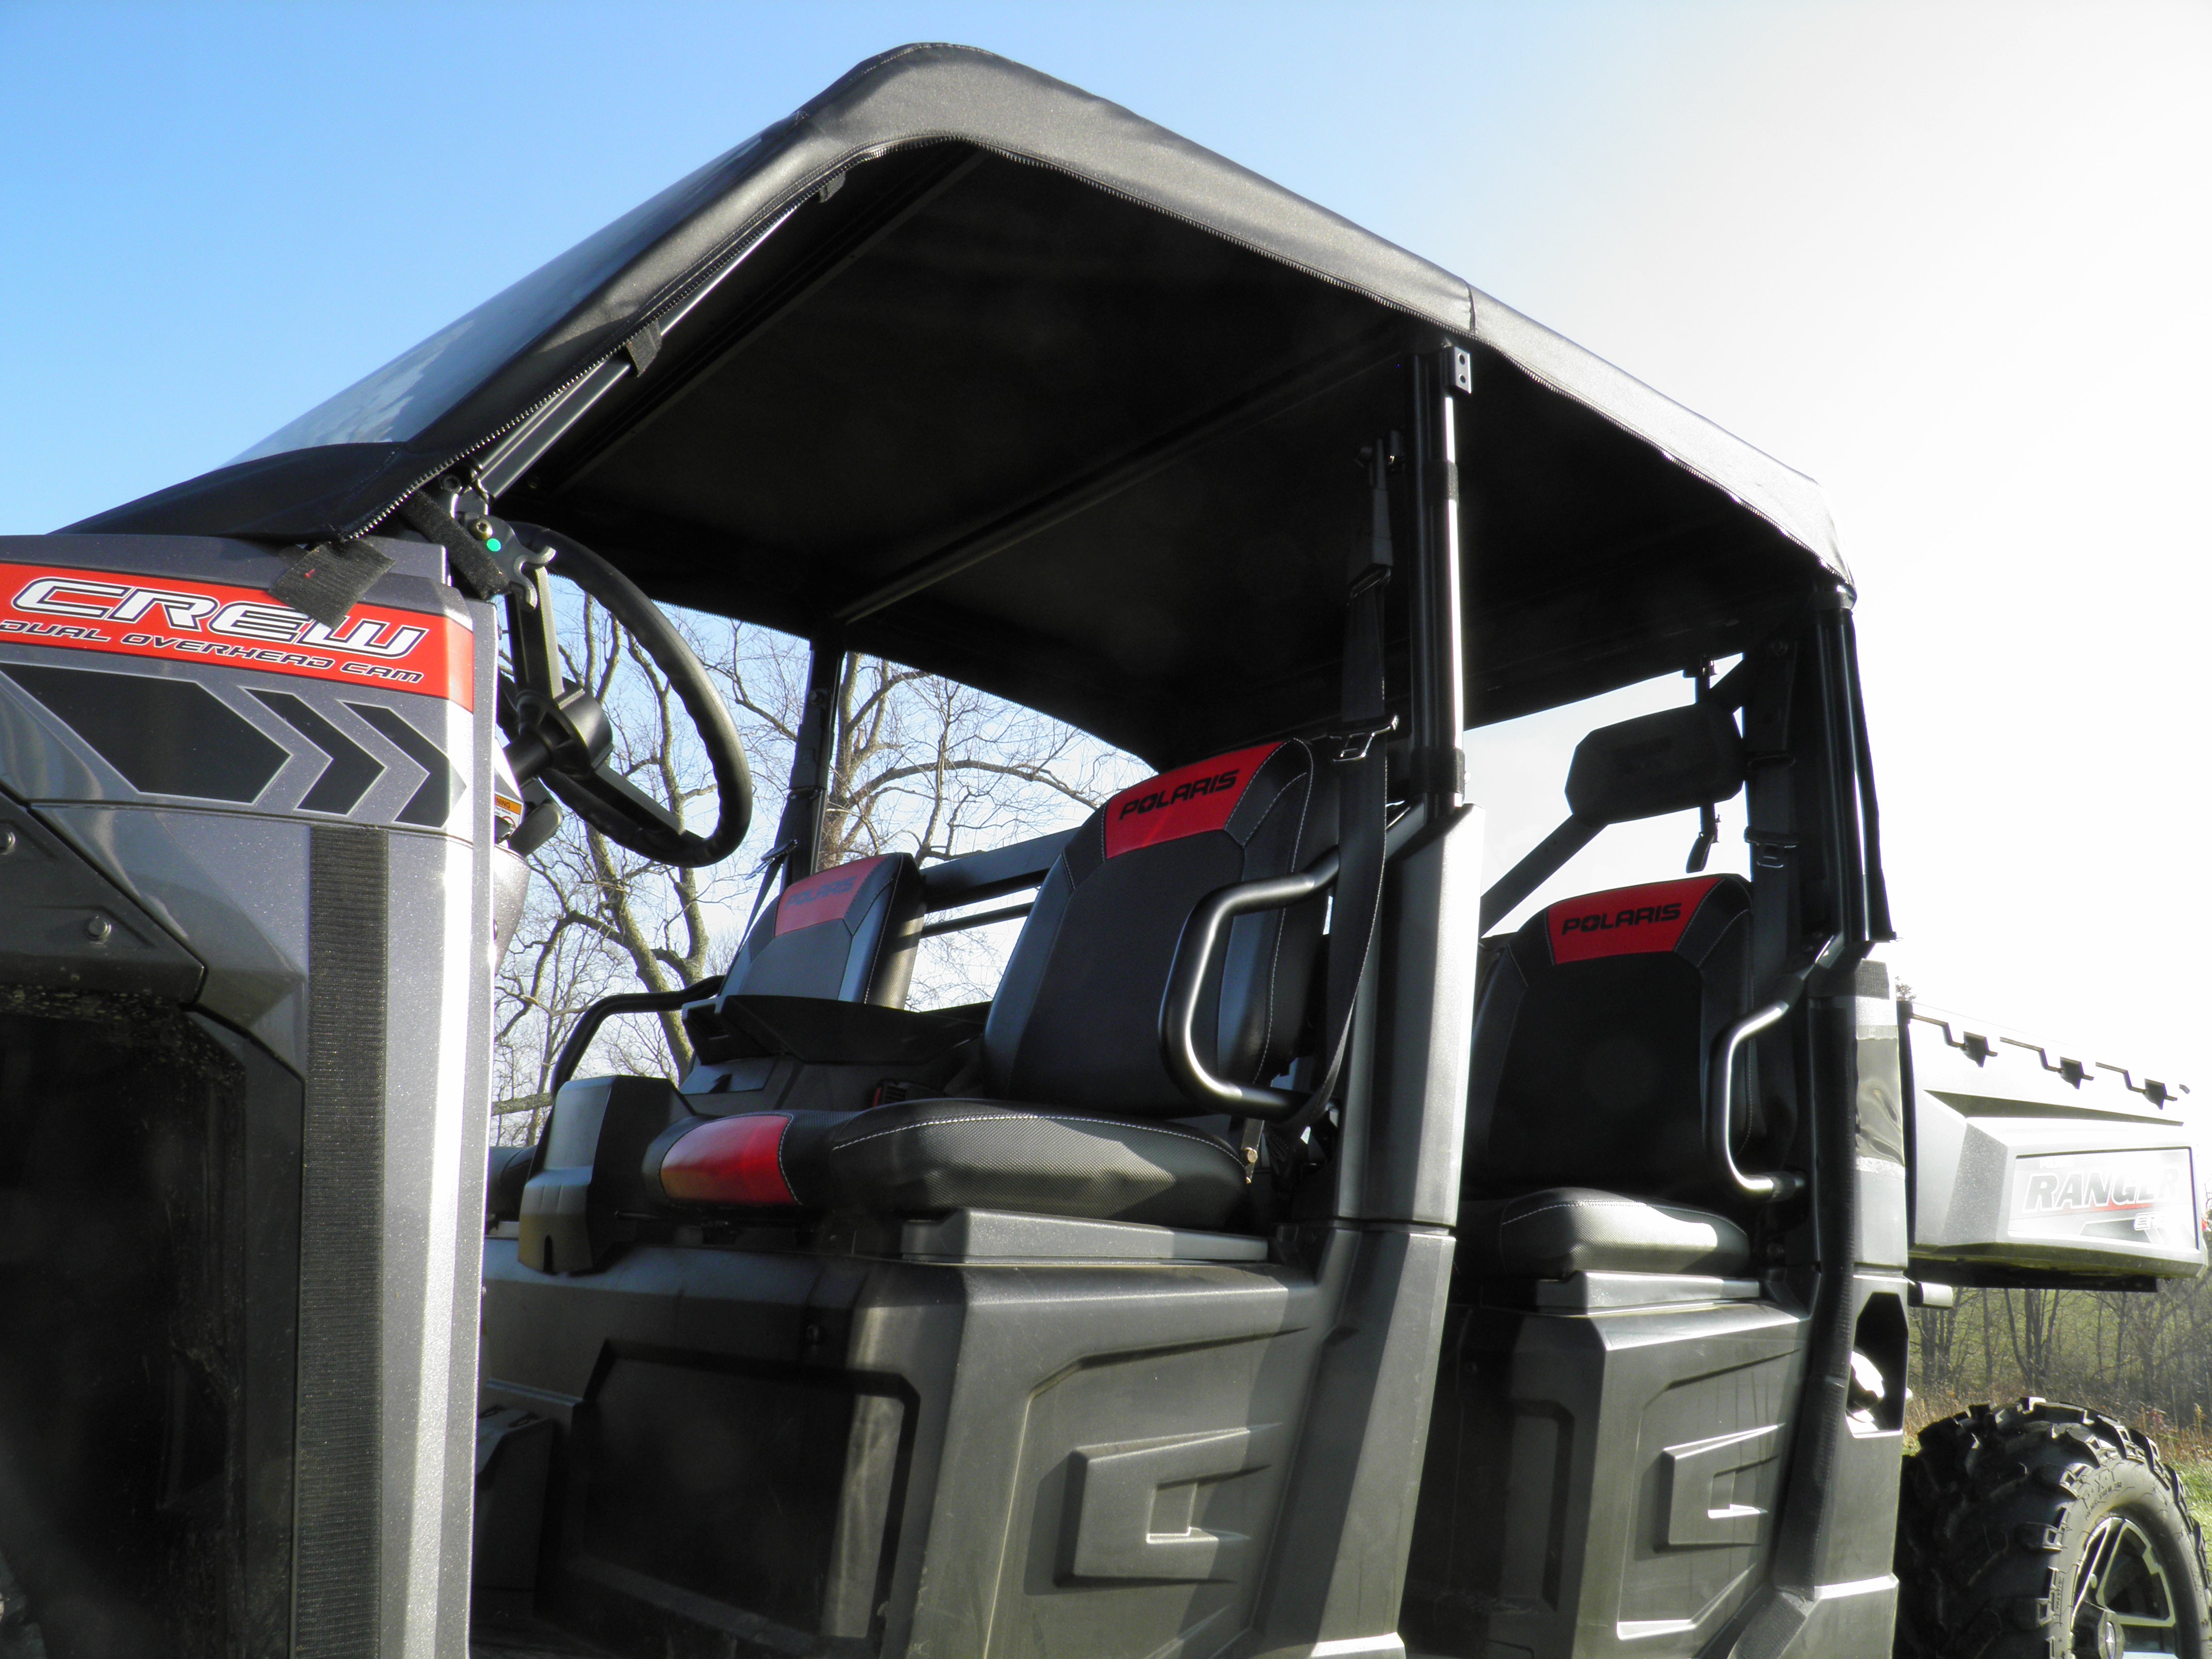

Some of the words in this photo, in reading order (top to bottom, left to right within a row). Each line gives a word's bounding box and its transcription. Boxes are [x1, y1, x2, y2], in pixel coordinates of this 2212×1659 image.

[11, 577, 430, 660] CREW
[0, 619, 111, 642] DUAL
[120, 632, 335, 670] OVERHEAD
[340, 661, 424, 684] CAM
[1118, 769, 1240, 821] POLARIS
[784, 876, 858, 910] POLARIS
[1561, 903, 1682, 936] POLARIS
